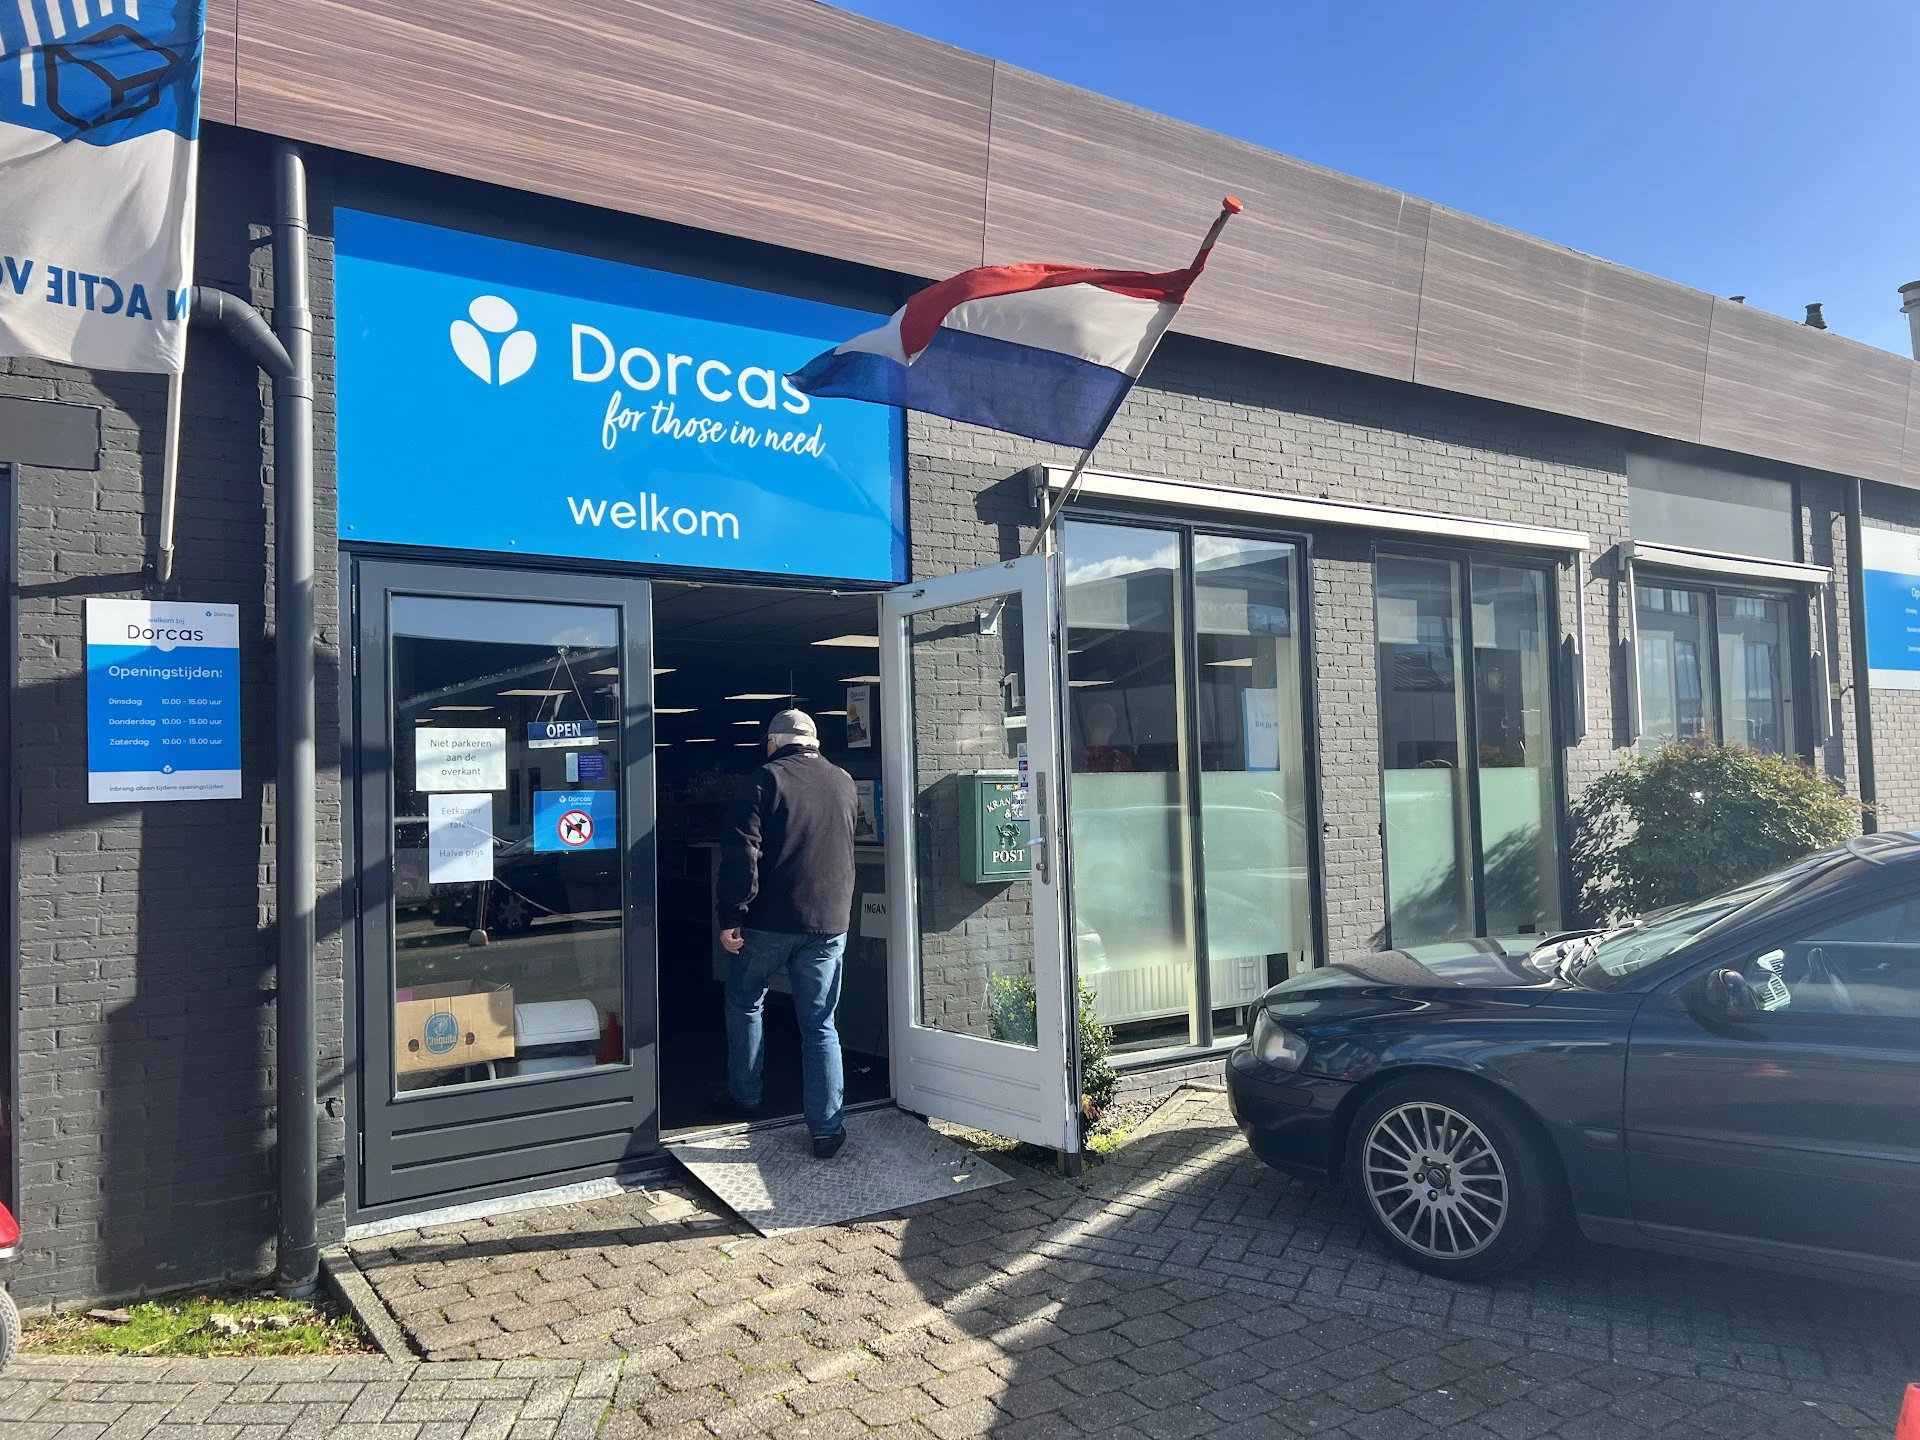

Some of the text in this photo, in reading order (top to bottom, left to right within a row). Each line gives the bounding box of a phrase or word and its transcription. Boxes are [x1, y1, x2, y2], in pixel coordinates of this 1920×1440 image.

[571, 323, 810, 415] Dorcas
[602, 390, 825, 457] for those in need
[567, 492, 739, 539] welkom
[176, 617, 185, 625] bij
[127, 624, 204, 641] Dorcas
[108, 665, 223, 680] Openingstijden:
[108, 698, 142, 706] Dinsdag
[108, 718, 156, 726] Donderdag
[546, 723, 581, 738] OPEN
[108, 738, 149, 746] Zaterdag
[430, 739, 492, 749] Niet parkeren
[464, 753, 476, 761] de
[441, 767, 481, 776] overkant
[986, 797, 1011, 813] KRAN
[441, 806, 481, 815] Eetkamer
[439, 849, 484, 858] Halve prijs
[992, 849, 1025, 863] POST
[864, 903, 887, 914] INGAN
